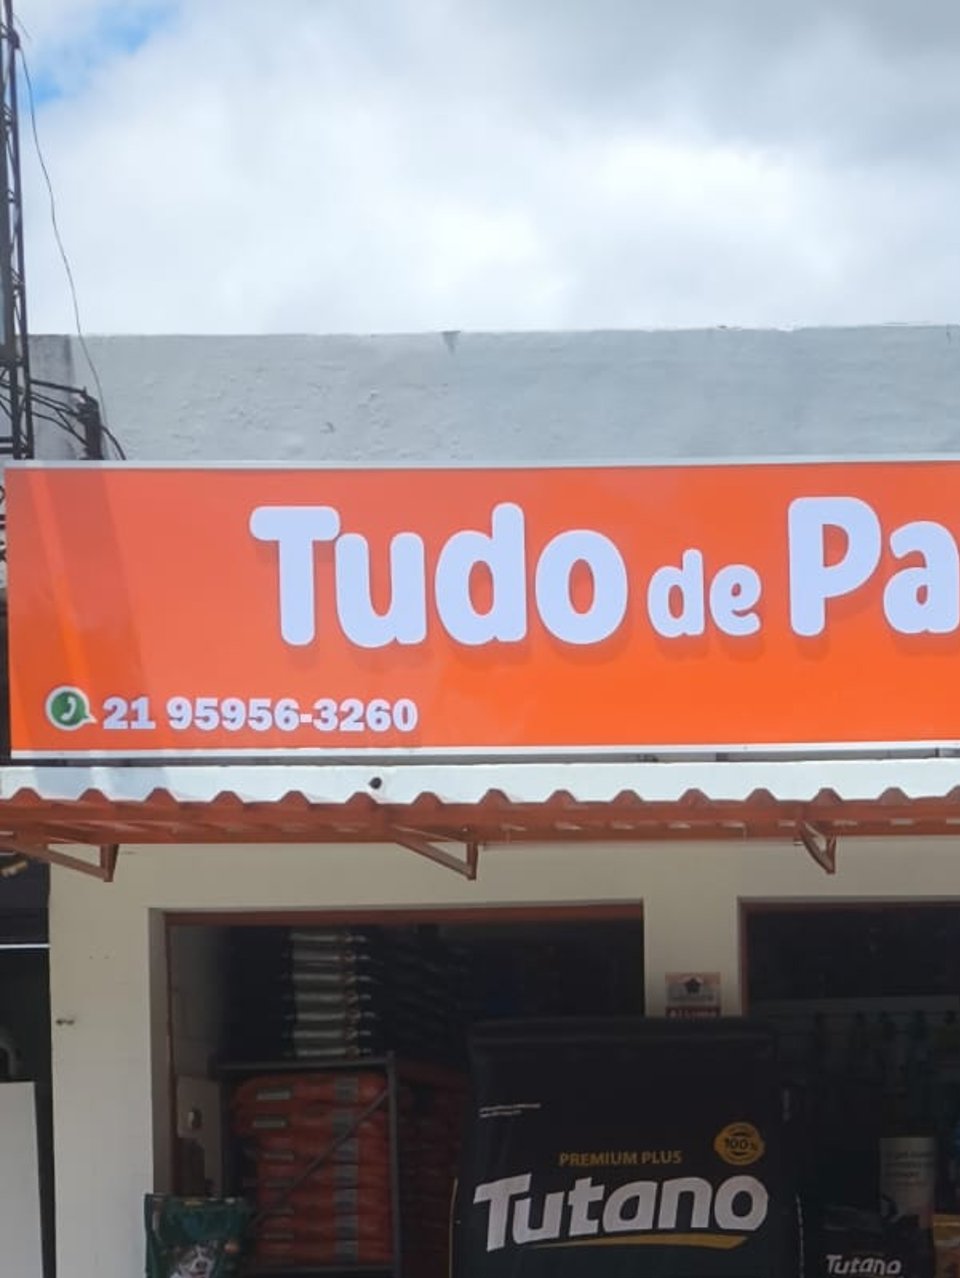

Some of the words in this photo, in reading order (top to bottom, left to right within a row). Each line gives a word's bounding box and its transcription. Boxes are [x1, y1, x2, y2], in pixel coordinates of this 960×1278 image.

[249, 501, 629, 648] Tudo
[646, 549, 762, 637] de
[102, 697, 156, 731] 21
[166, 697, 419, 733] 95956-3260
[558, 1151, 638, 1167] PREMIUM
[640, 1150, 683, 1165] PLUS
[473, 1172, 769, 1252] Tutano
[825, 1253, 902, 1276] Tutano
